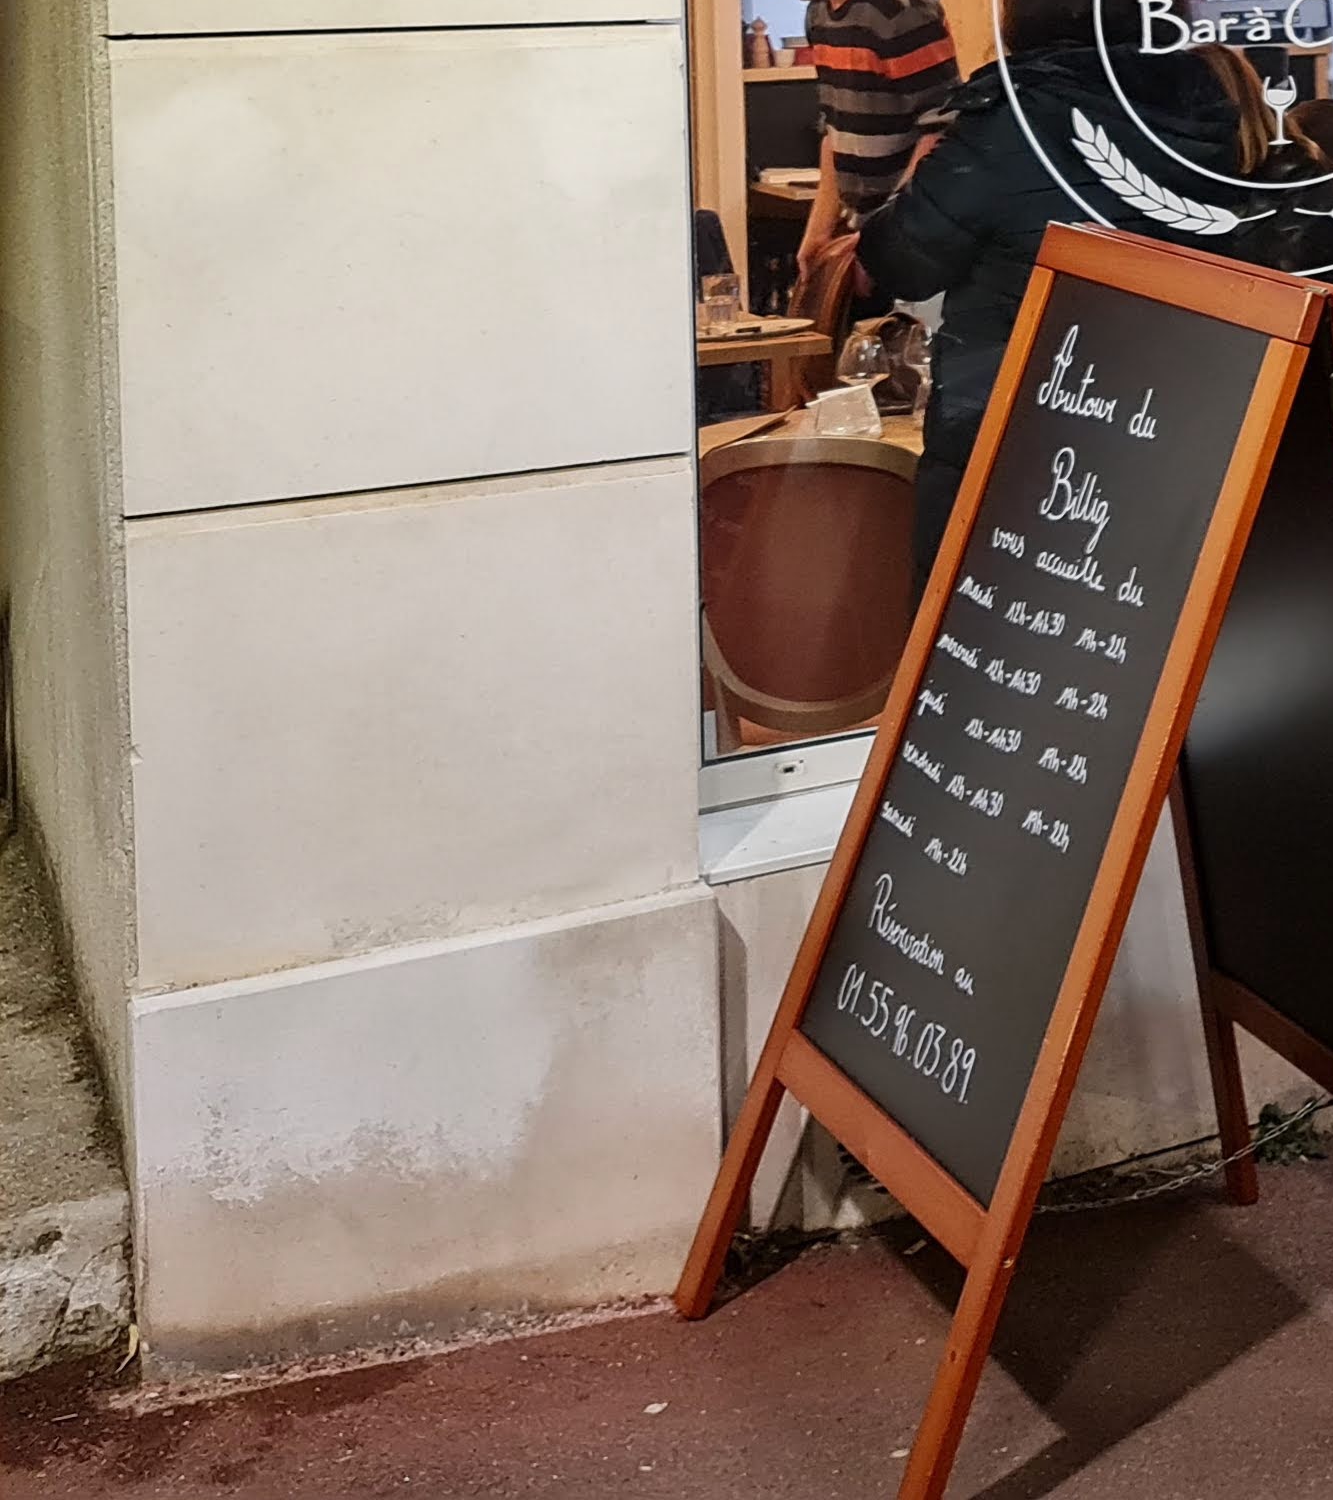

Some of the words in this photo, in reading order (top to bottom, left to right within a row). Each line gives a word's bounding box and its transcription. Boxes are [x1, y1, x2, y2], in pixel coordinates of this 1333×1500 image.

[1239, 6, 1273, 43] à
[1038, 324, 1117, 423] Autour
[1129, 388, 1156, 439] du
[1040, 447, 1110, 554] Billig
[958, 575, 998, 609] mardi
[992, 527, 1025, 558] vous
[1036, 551, 1105, 592] accueille
[1118, 566, 1144, 607] du
[936, 633, 981, 669] mercredi
[869, 873, 944, 975] Réservation
[954, 967, 973, 996] au
